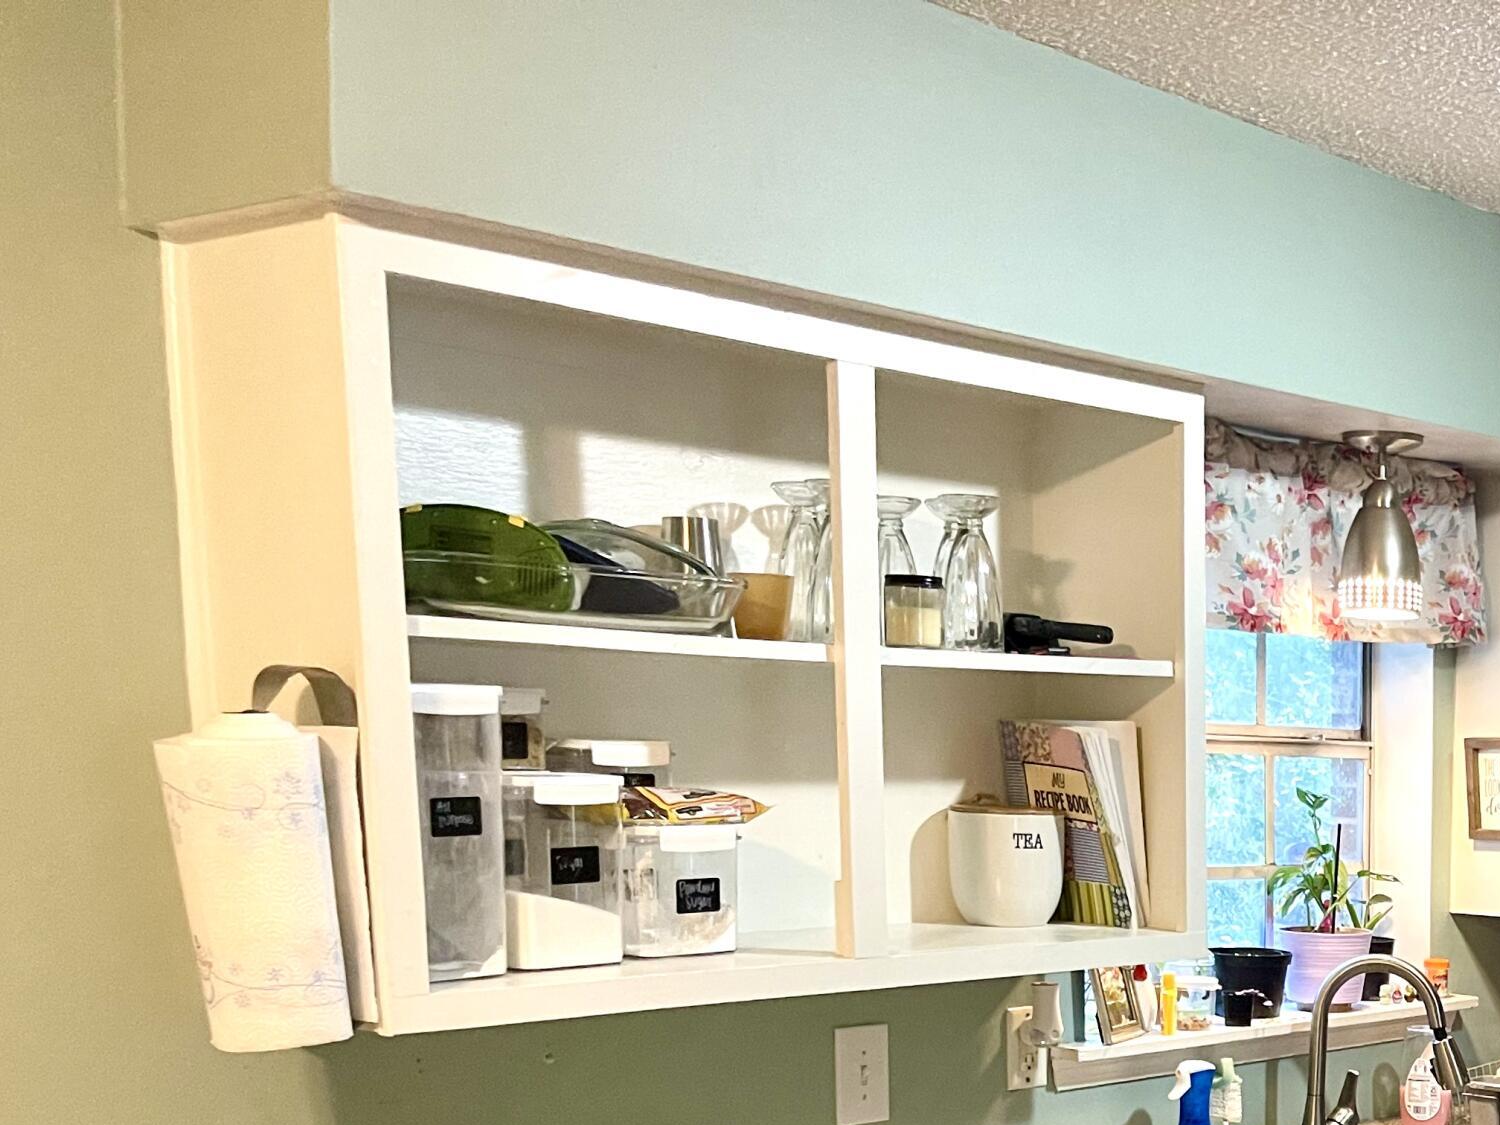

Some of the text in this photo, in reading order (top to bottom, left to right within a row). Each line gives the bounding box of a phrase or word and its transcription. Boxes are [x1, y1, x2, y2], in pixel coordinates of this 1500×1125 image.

[1051, 771, 1066, 789] MY
[1034, 789, 1093, 815] RECIPE BOOK
[1012, 833, 1044, 850] TEA
